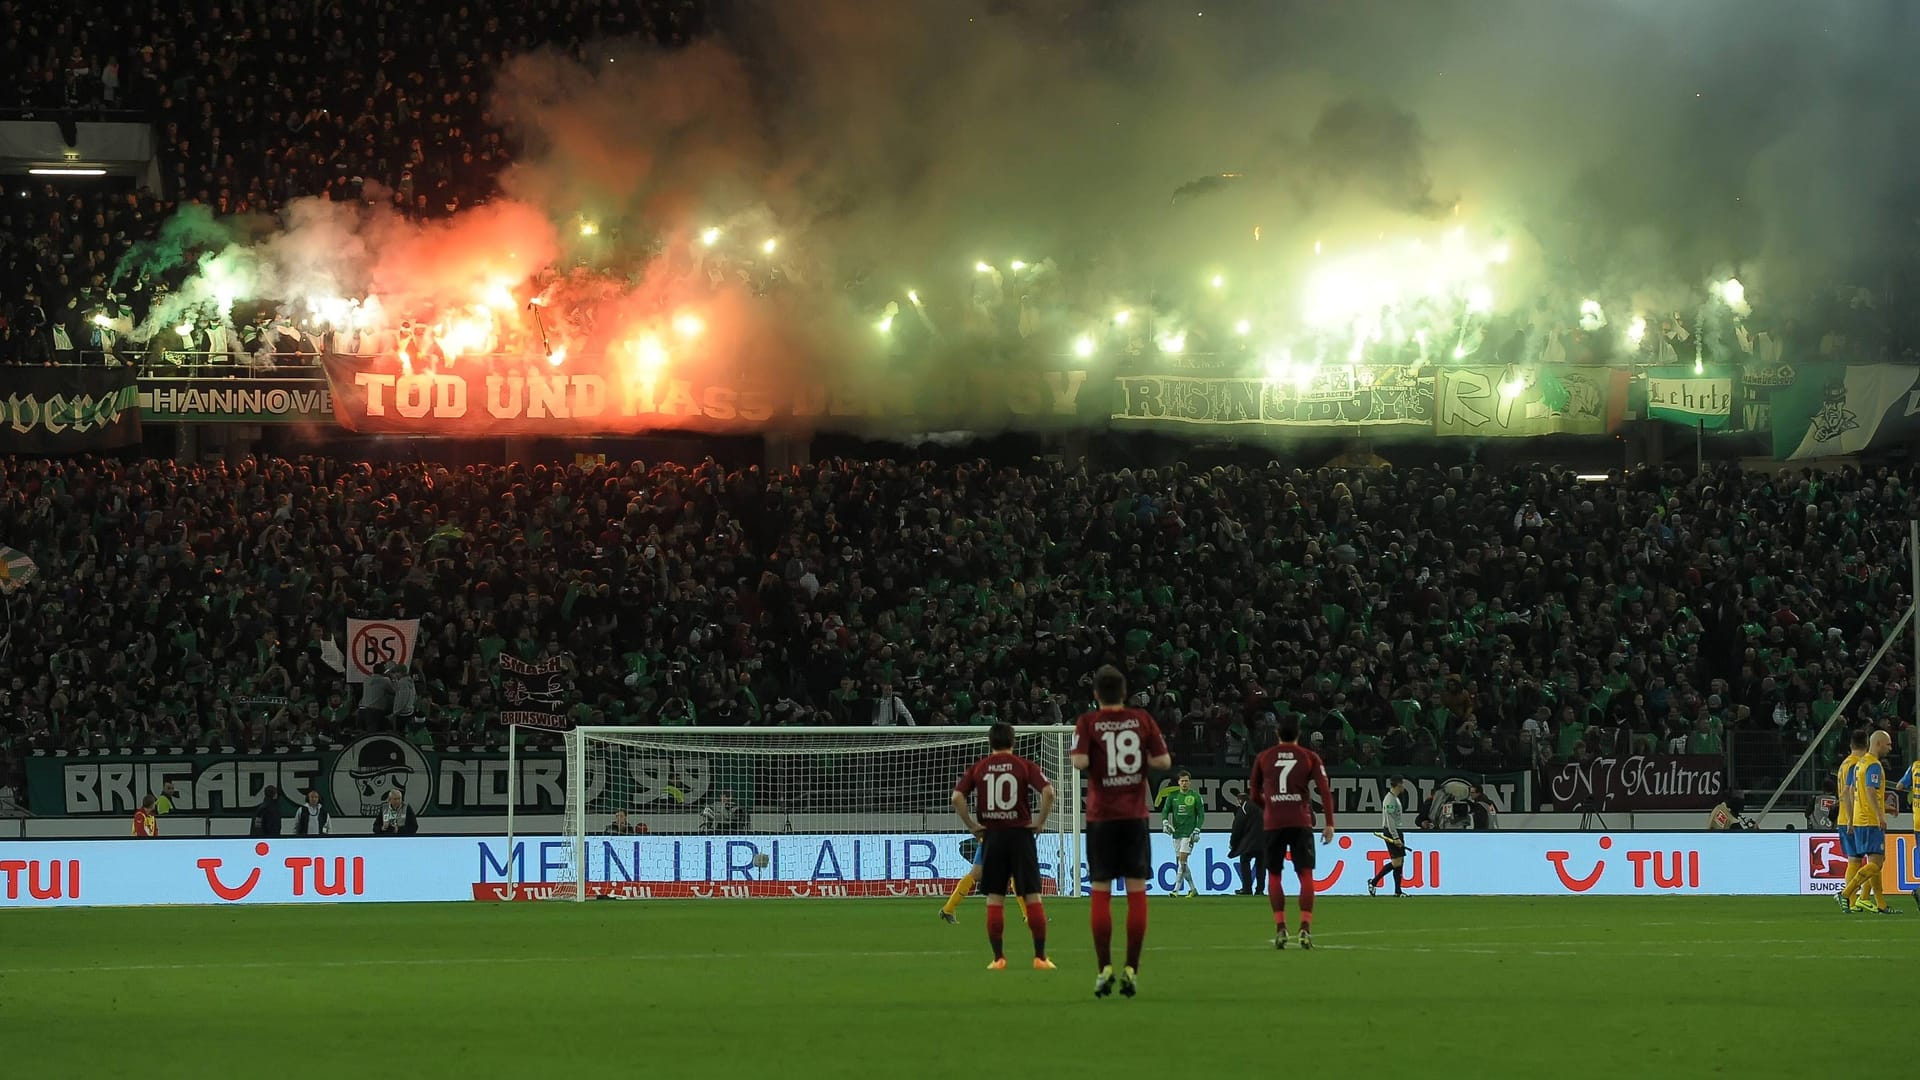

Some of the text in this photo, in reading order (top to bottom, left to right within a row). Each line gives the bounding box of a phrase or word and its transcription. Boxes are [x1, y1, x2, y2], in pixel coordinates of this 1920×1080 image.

[354, 372, 467, 418] TOD
[486, 374, 605, 418] UND
[1651, 381, 1729, 415] Lehrte
[364, 636, 396, 666] BS
[500, 653, 561, 675] SMASH
[500, 711, 567, 728] BRUNSWICK
[1101, 730, 1142, 777] 18
[64, 757, 711, 814] BRIGADE NORD 99
[982, 773, 1018, 811] 10
[1274, 759, 1298, 794] 7
[1620, 755, 1721, 796] Kultras
[0, 859, 80, 899] TUI
[285, 856, 365, 896] TUI
[477, 841, 640, 882] MEIN
[1366, 850, 1440, 888] TUI
[1626, 850, 1700, 888] TUI
